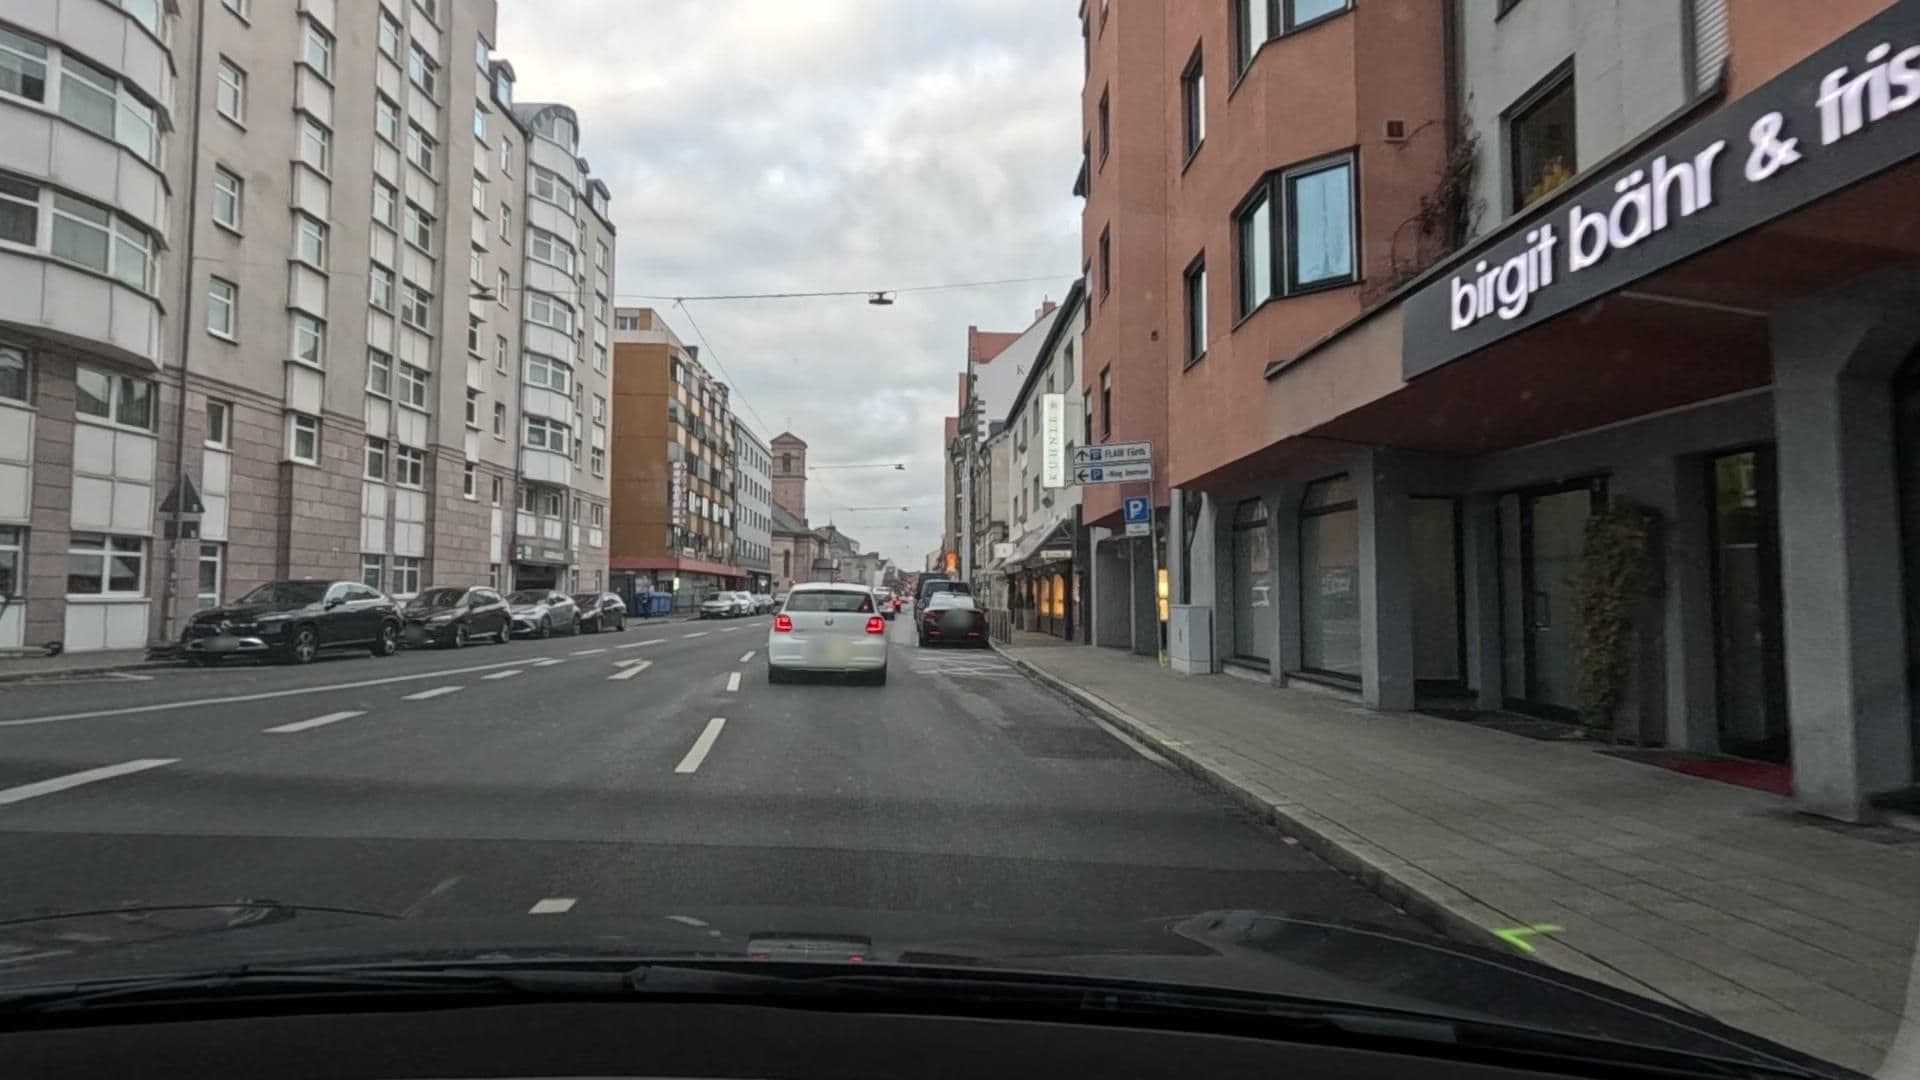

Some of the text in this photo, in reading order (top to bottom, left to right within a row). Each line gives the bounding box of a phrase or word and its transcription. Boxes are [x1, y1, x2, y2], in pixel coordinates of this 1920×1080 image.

[1451, 223, 1558, 332] birgit
[1568, 140, 1726, 273] bähr
[1745, 112, 1804, 183] &
[1129, 500, 1143, 519] P
